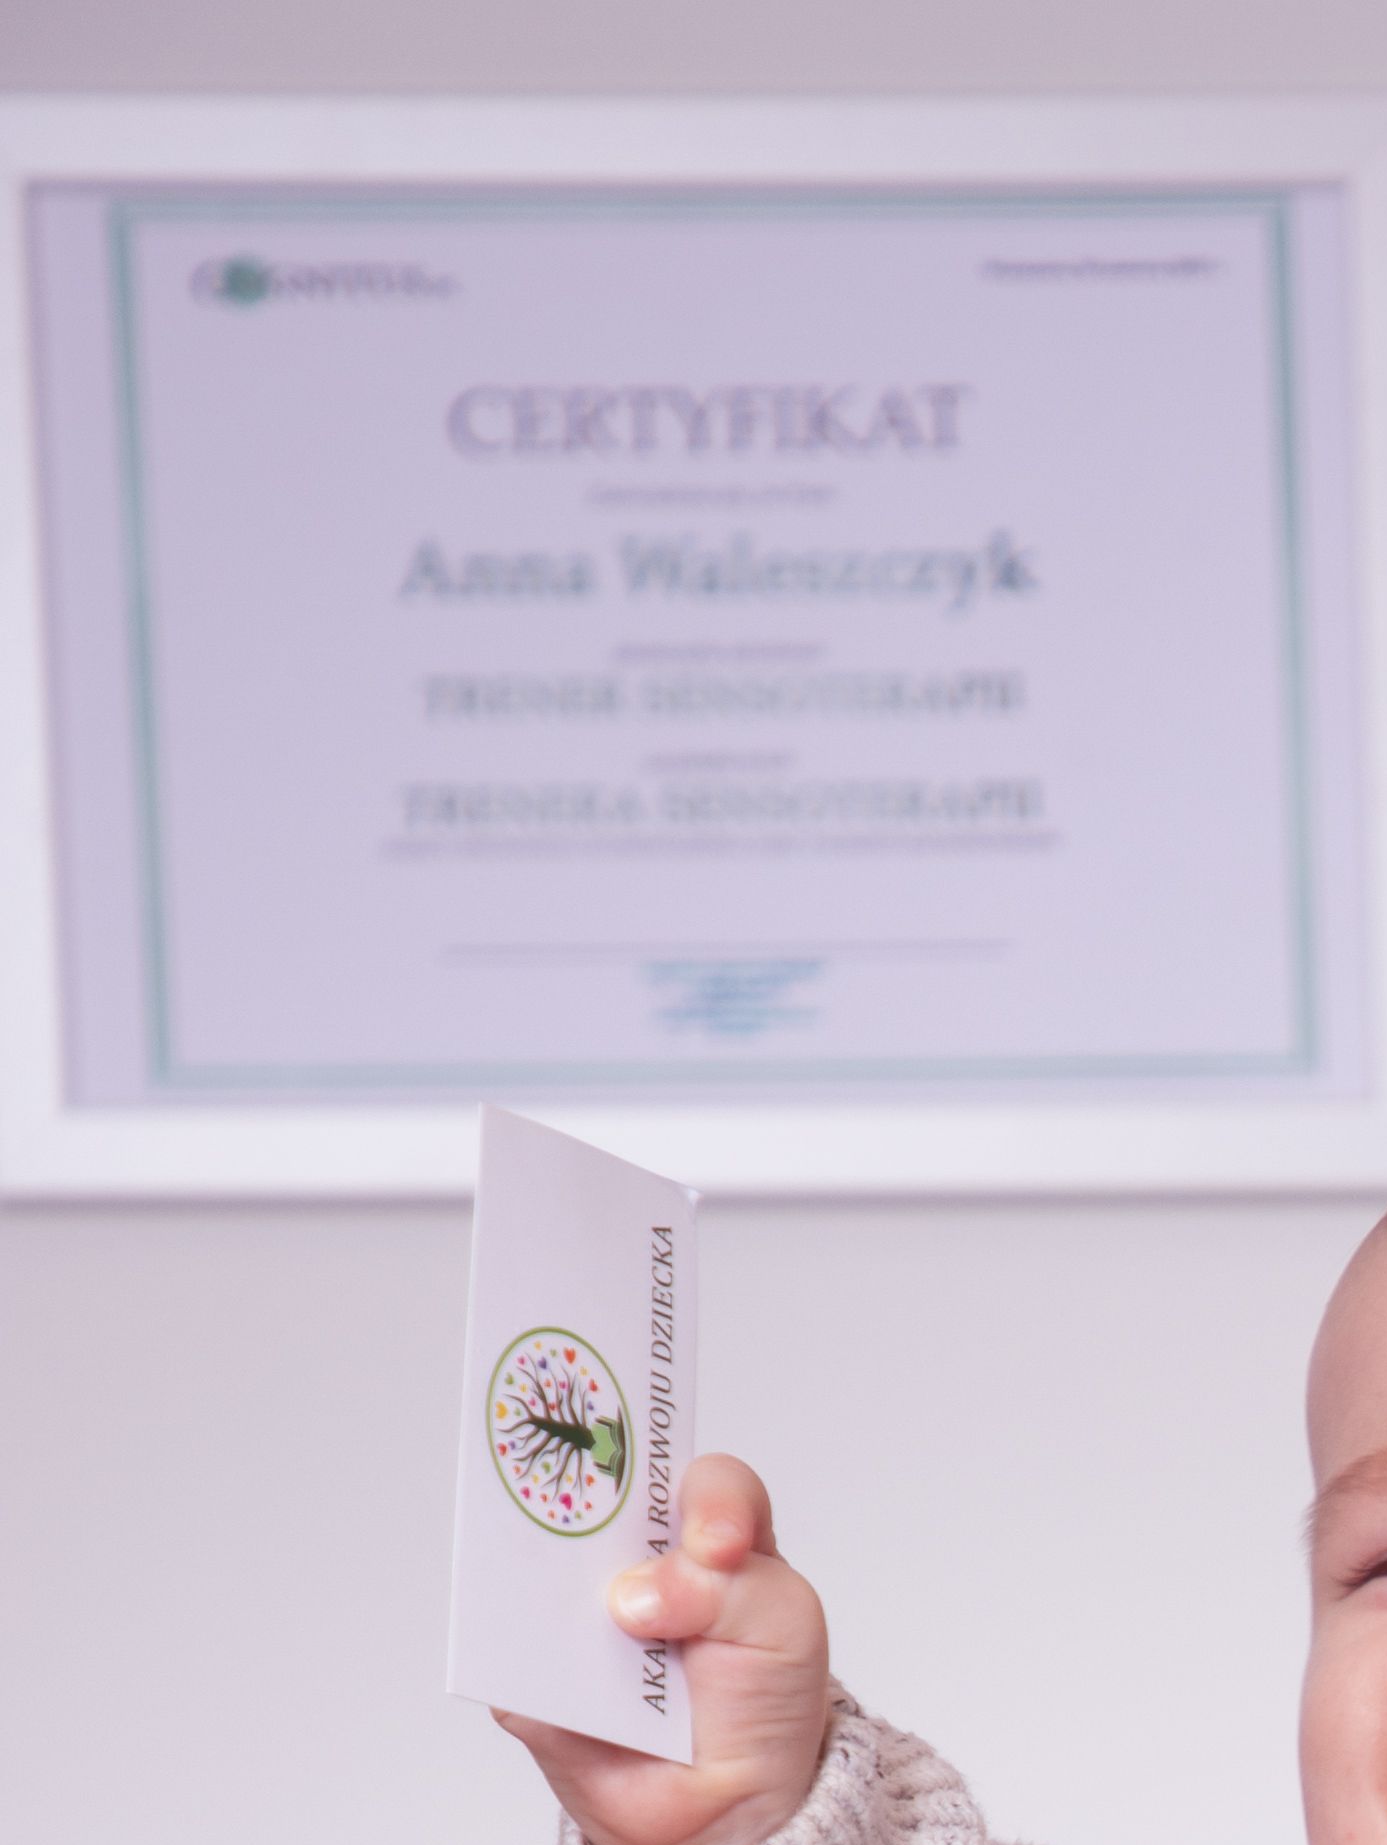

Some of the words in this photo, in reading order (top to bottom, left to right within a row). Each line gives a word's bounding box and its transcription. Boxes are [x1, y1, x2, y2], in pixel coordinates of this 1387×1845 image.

[445, 382, 975, 458] CERTYFIKAT
[399, 533, 595, 600] Anna
[619, 526, 1040, 618] Waleszczyk
[650, 1226, 673, 1364] DZIECKA
[648, 1370, 677, 1529] ROZWOJU
